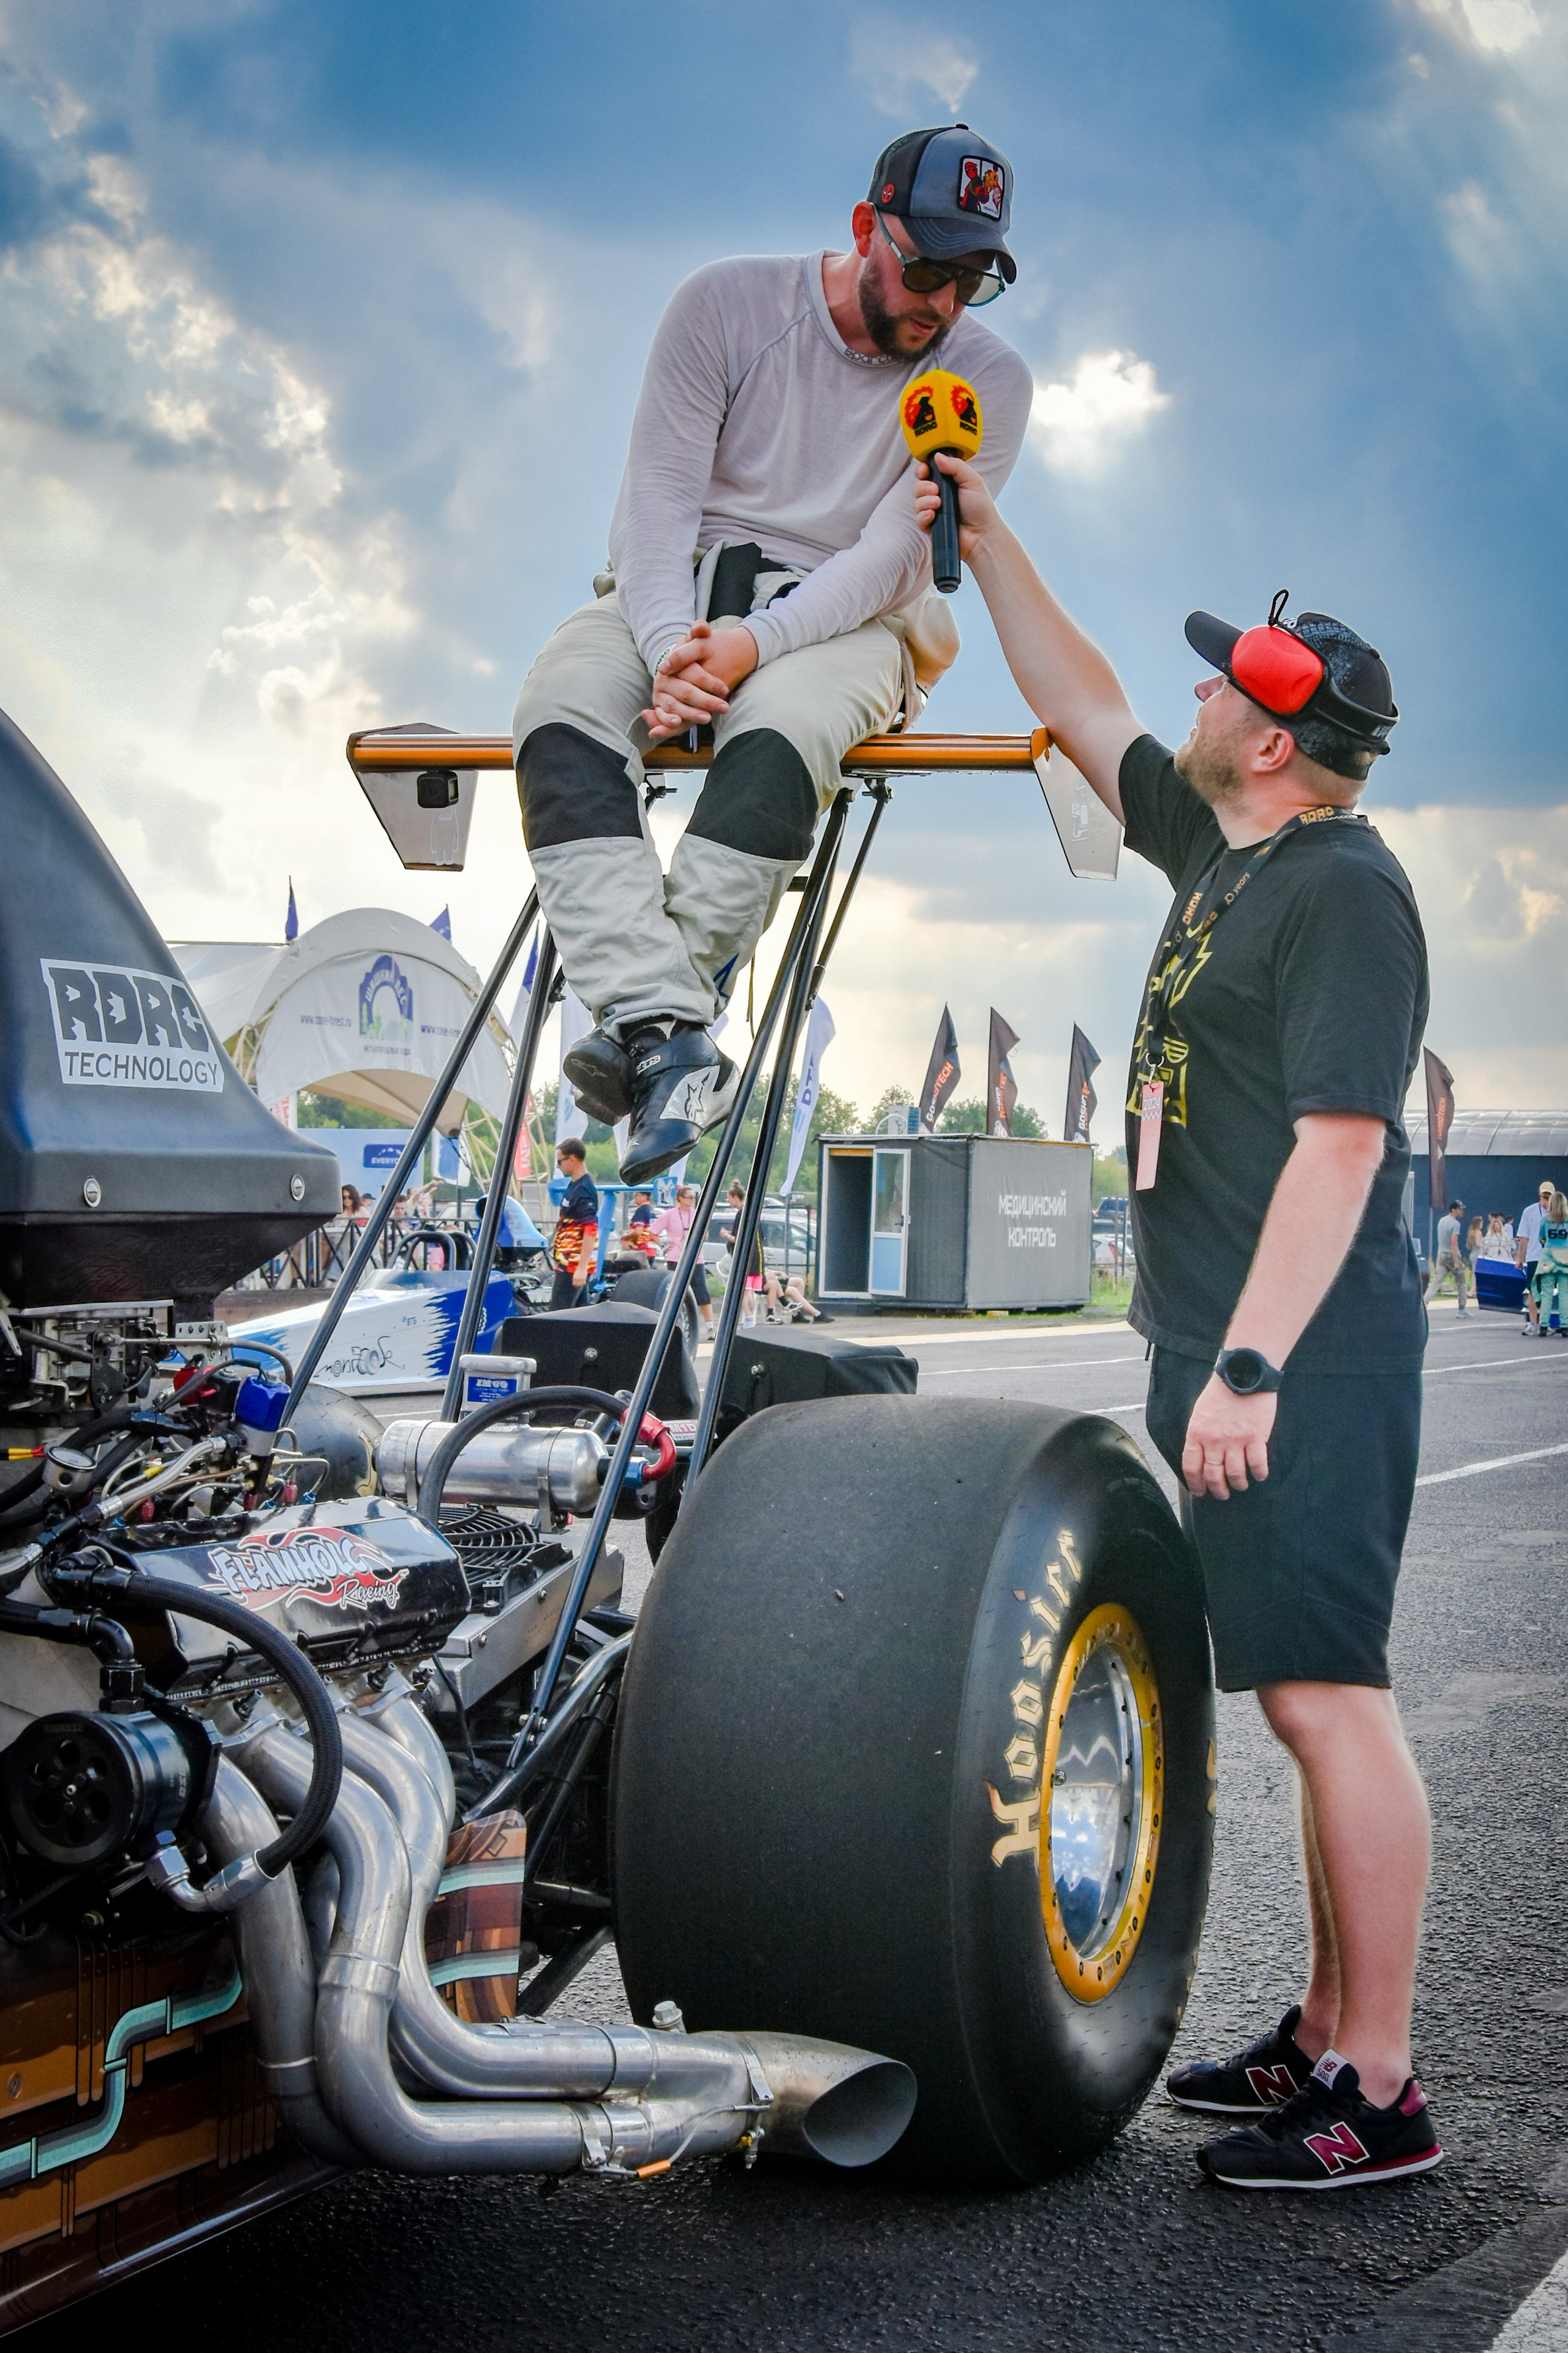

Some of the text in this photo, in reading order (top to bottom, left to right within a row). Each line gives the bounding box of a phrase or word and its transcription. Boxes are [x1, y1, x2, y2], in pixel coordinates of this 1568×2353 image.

[1299, 806, 1335, 825] RDRC
[1232, 872, 1251, 896] years
[48, 967, 209, 1053] RDRC
[64, 1051, 217, 1086] TECHNOLOGY
[1143, 1096, 1161, 1111] 2024
[999, 1189, 1067, 1218] МЕДИЦИНСКИЙ
[1008, 1227, 1057, 1247] КОНТРОЛЬ
[1548, 1229, 1567, 1239] 69
[337, 1578, 401, 1609] Racing
[1245, 2064, 1300, 2106] N
[1317, 2069, 1329, 2082] 500
[1303, 2121, 1370, 2175] N
